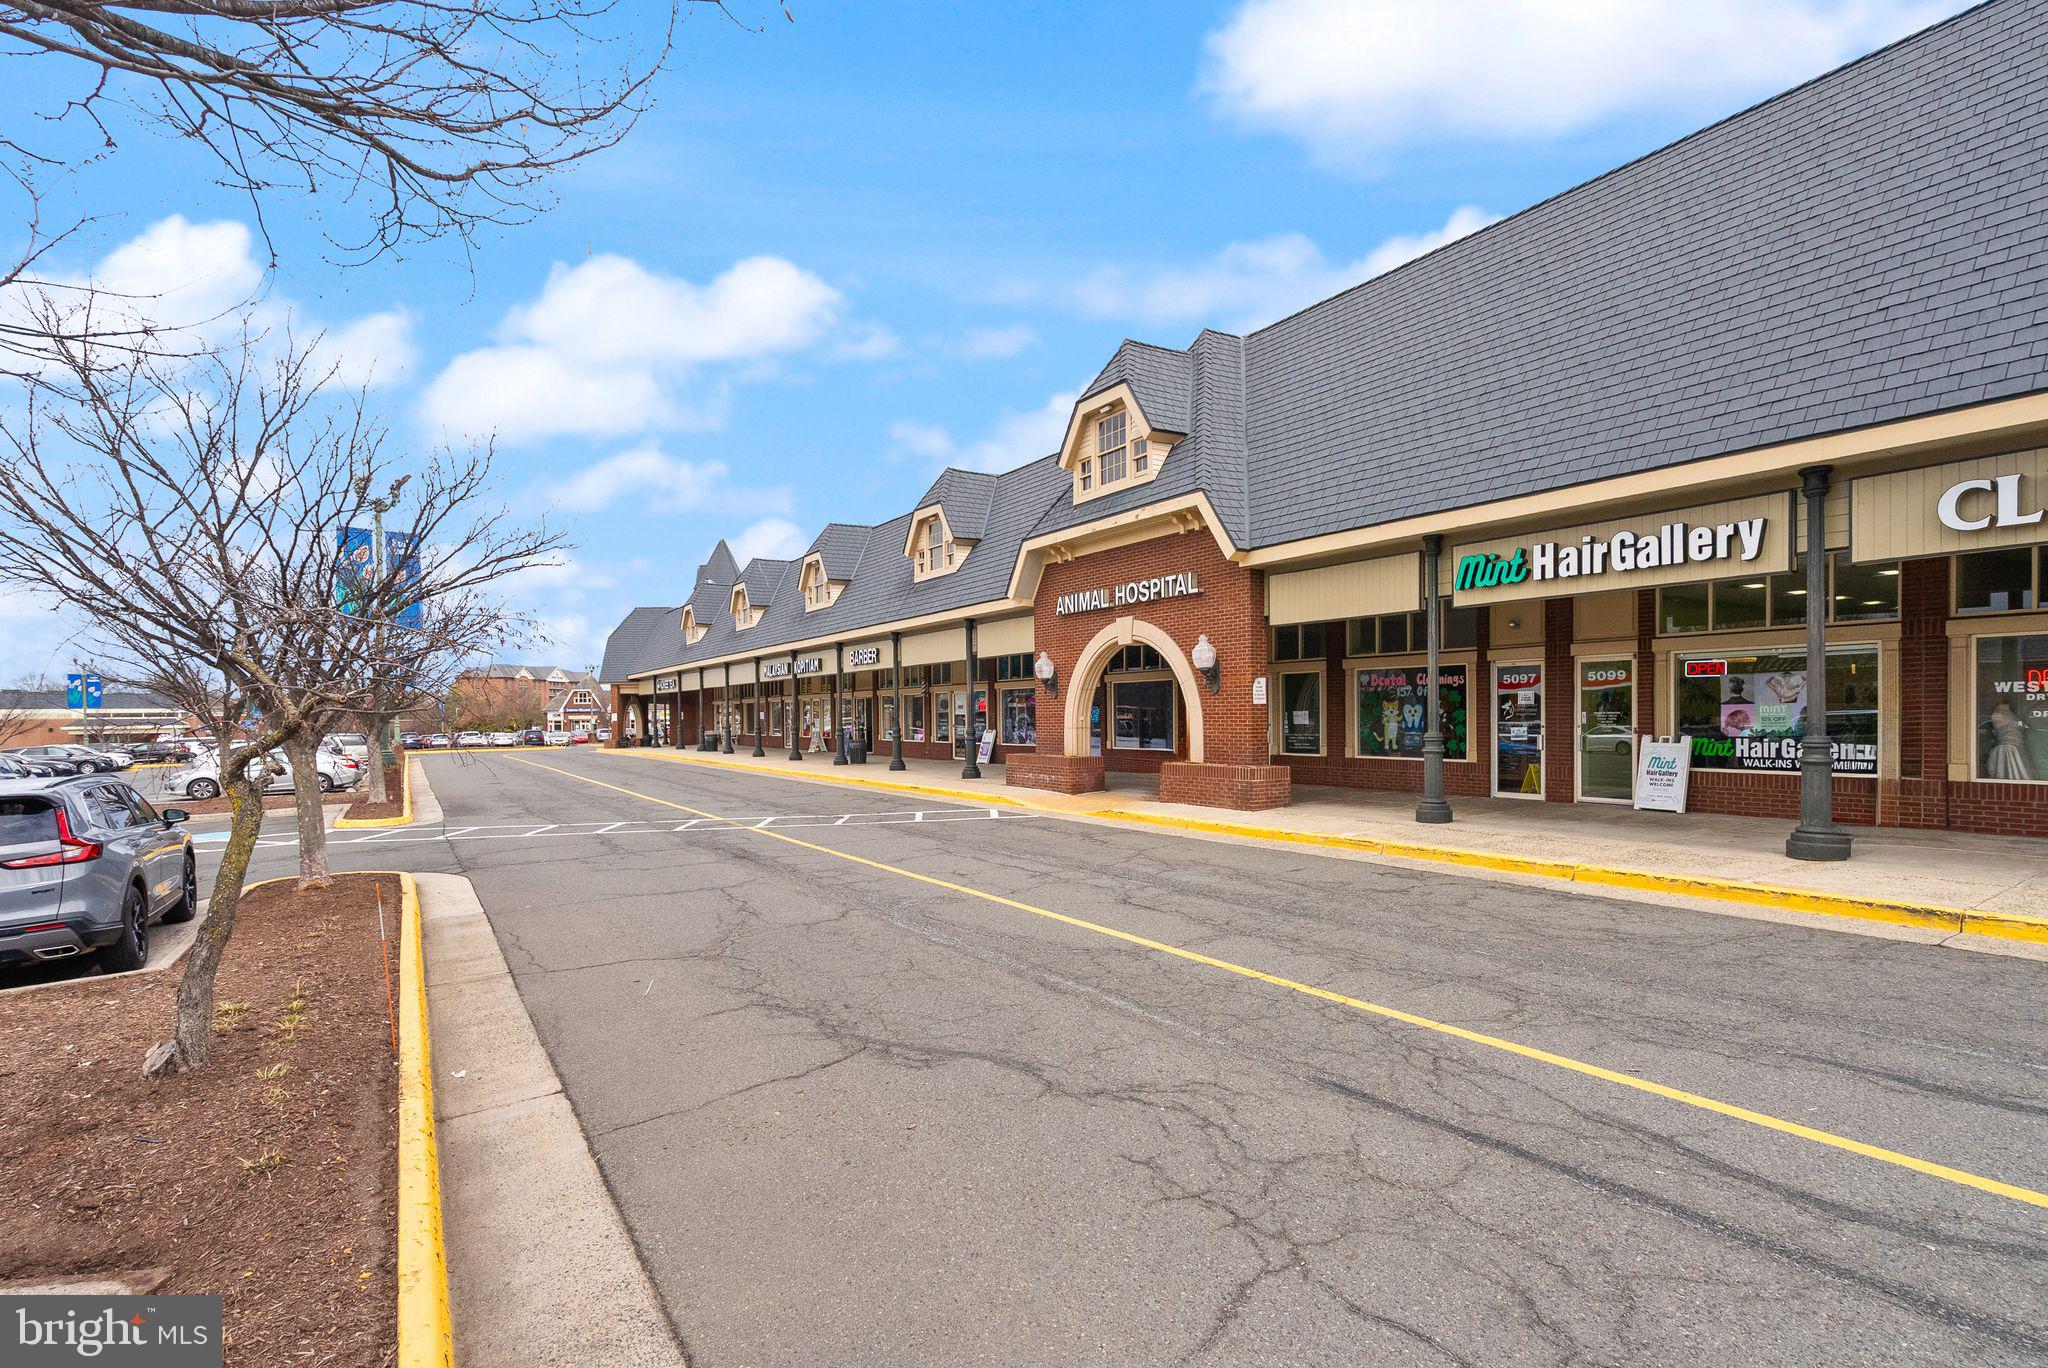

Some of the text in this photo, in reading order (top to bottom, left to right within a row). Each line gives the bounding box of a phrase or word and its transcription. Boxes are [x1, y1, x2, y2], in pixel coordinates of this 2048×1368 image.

[1455, 517, 1768, 591] Mint HairGallery
[1056, 571, 1199, 616] ANIMAL HOSPITAL
[850, 648, 877, 666] BARBER
[1687, 662, 1725, 675] OPEN
[1370, 673, 1465, 687] Dental Clnings
[1503, 673, 1537, 684] 5097
[1587, 670, 1627, 681] 5099
[1417, 686, 1428, 697] Of
[1691, 738, 1735, 756] Mint
[1647, 754, 1678, 769] Mint
[1743, 758, 1793, 769] WALK-INS
[31, 887, 56, 895] SPORT
